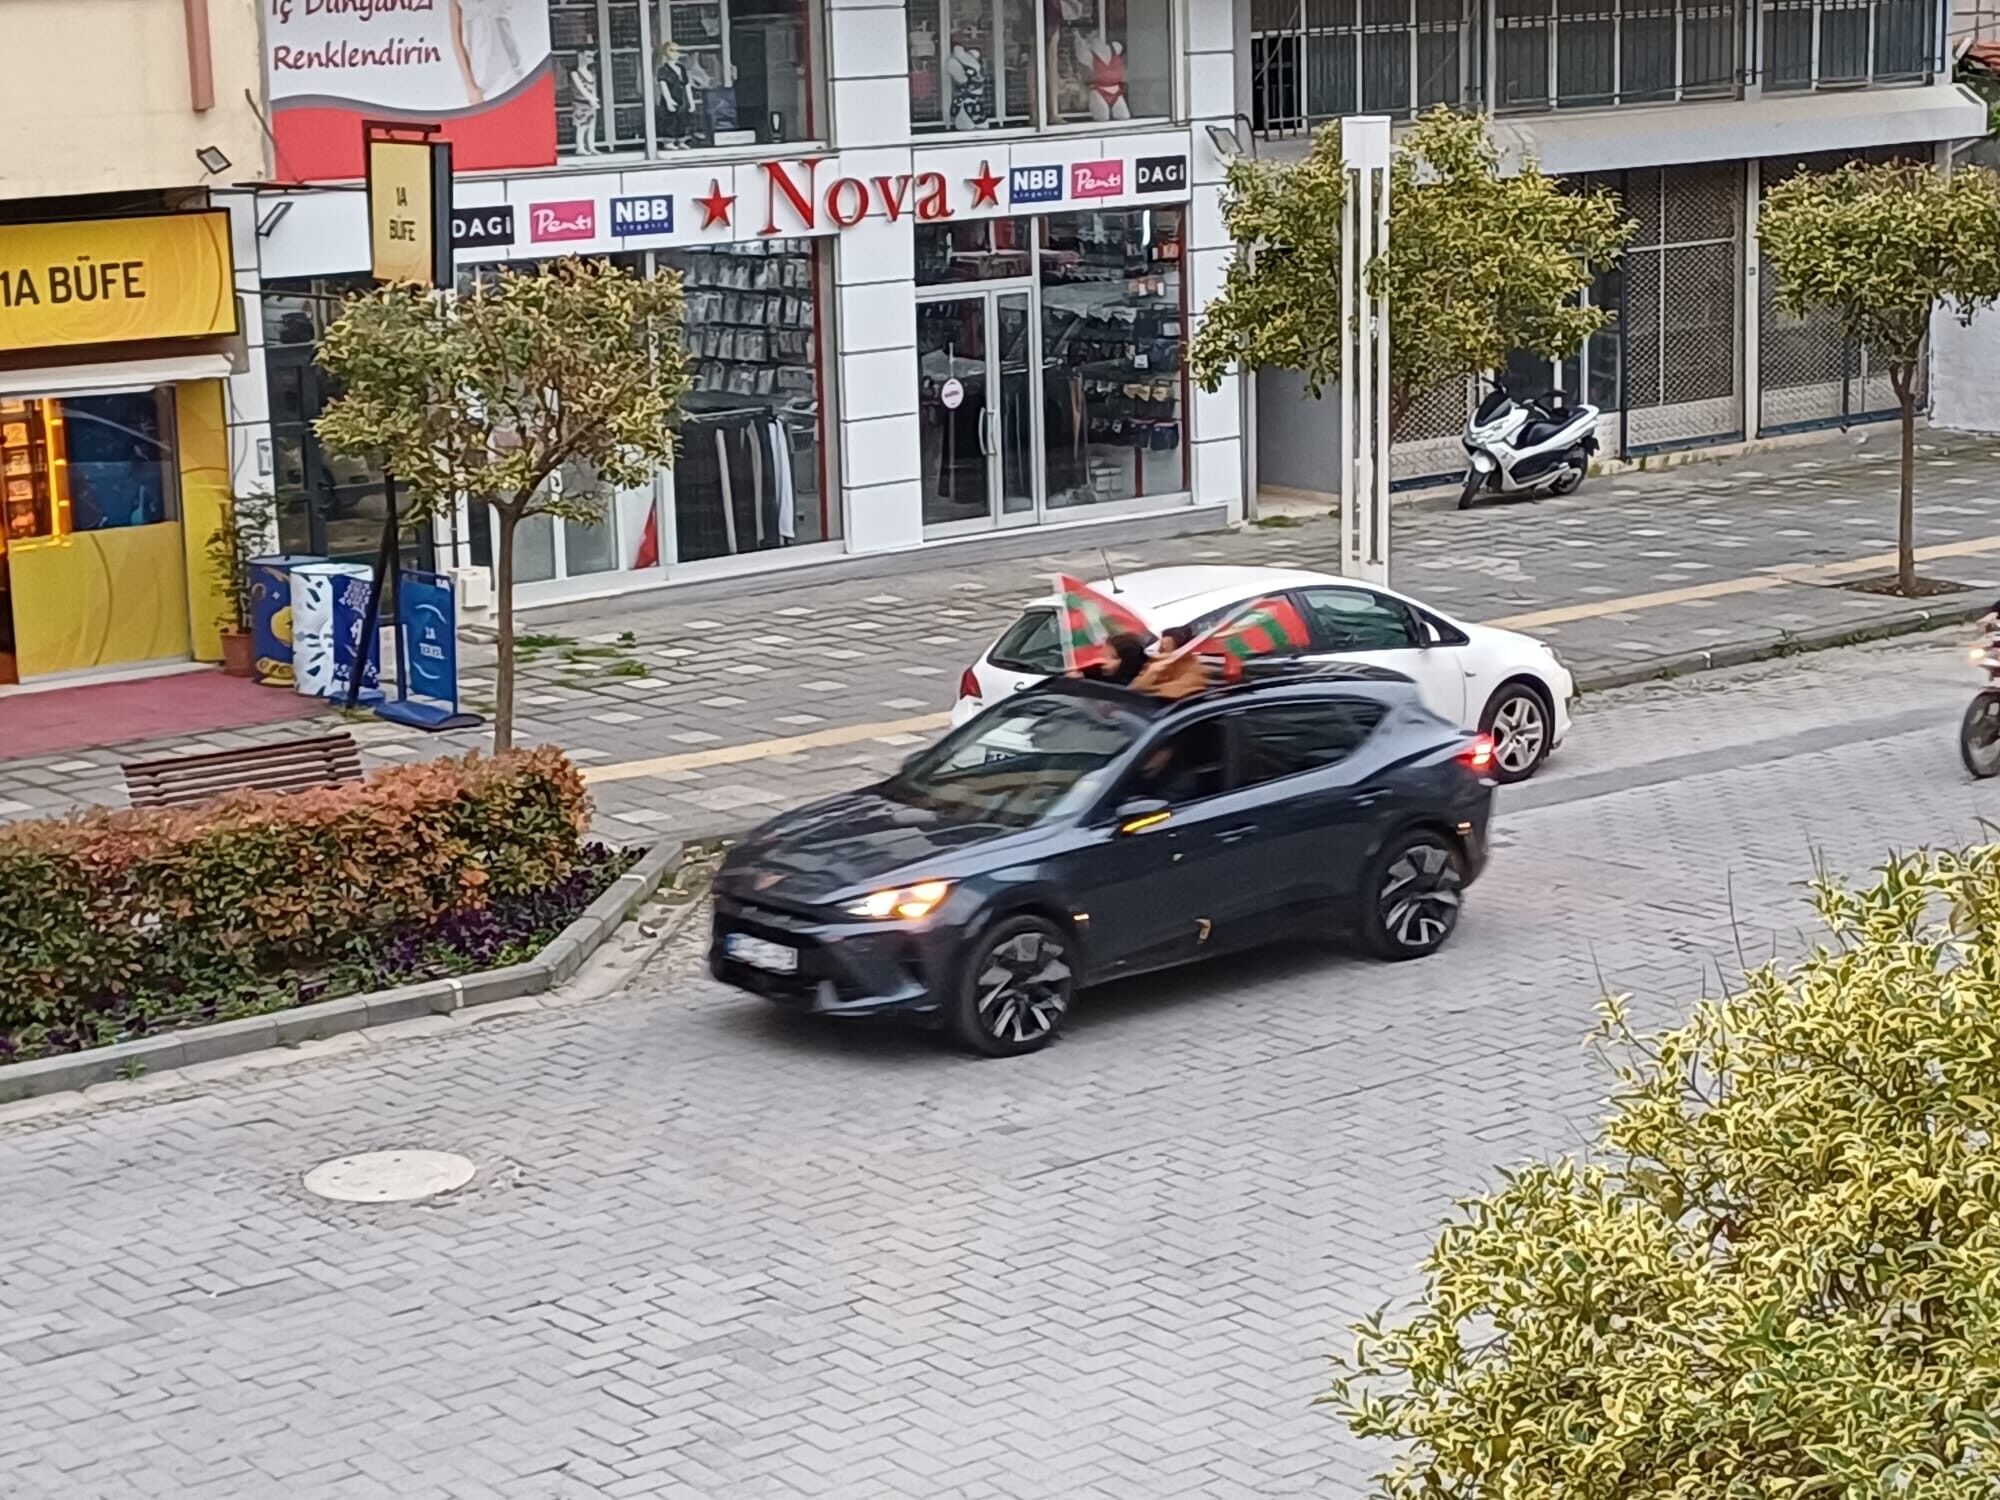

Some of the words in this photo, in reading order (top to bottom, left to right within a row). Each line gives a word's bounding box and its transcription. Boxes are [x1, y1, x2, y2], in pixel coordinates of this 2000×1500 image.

[273, 37, 442, 71] Renklendirin
[1013, 168, 1059, 191] NBB
[615, 198, 669, 223] NBB
[757, 158, 955, 236] Nova
[0, 268, 41, 308] 1A
[47, 254, 146, 304] BÜFE
